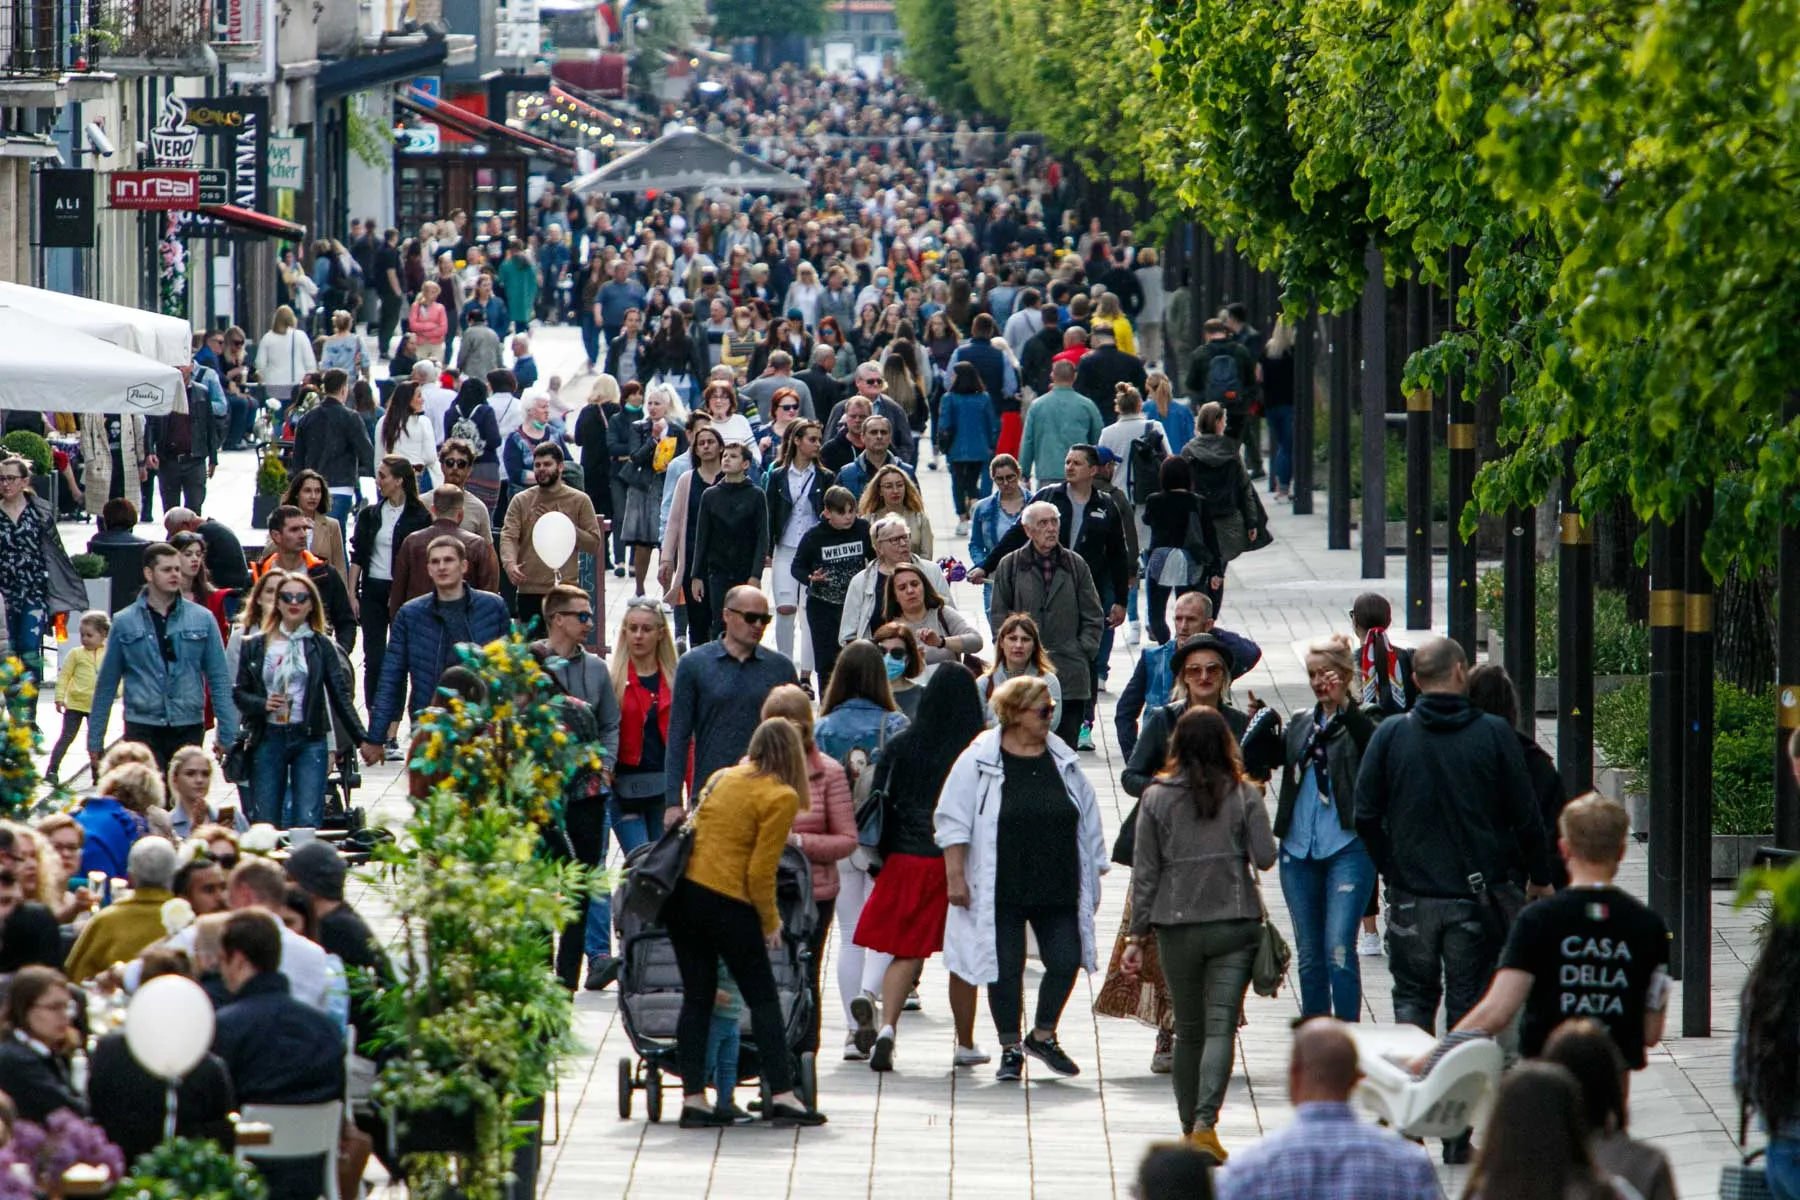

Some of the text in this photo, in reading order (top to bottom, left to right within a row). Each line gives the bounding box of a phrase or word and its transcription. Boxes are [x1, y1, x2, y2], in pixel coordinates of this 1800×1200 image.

[154, 137, 194, 156] VERO
[56, 197, 80, 209] ALI
[1560, 936, 1632, 960] CASA
[1560, 964, 1629, 988] DELLA
